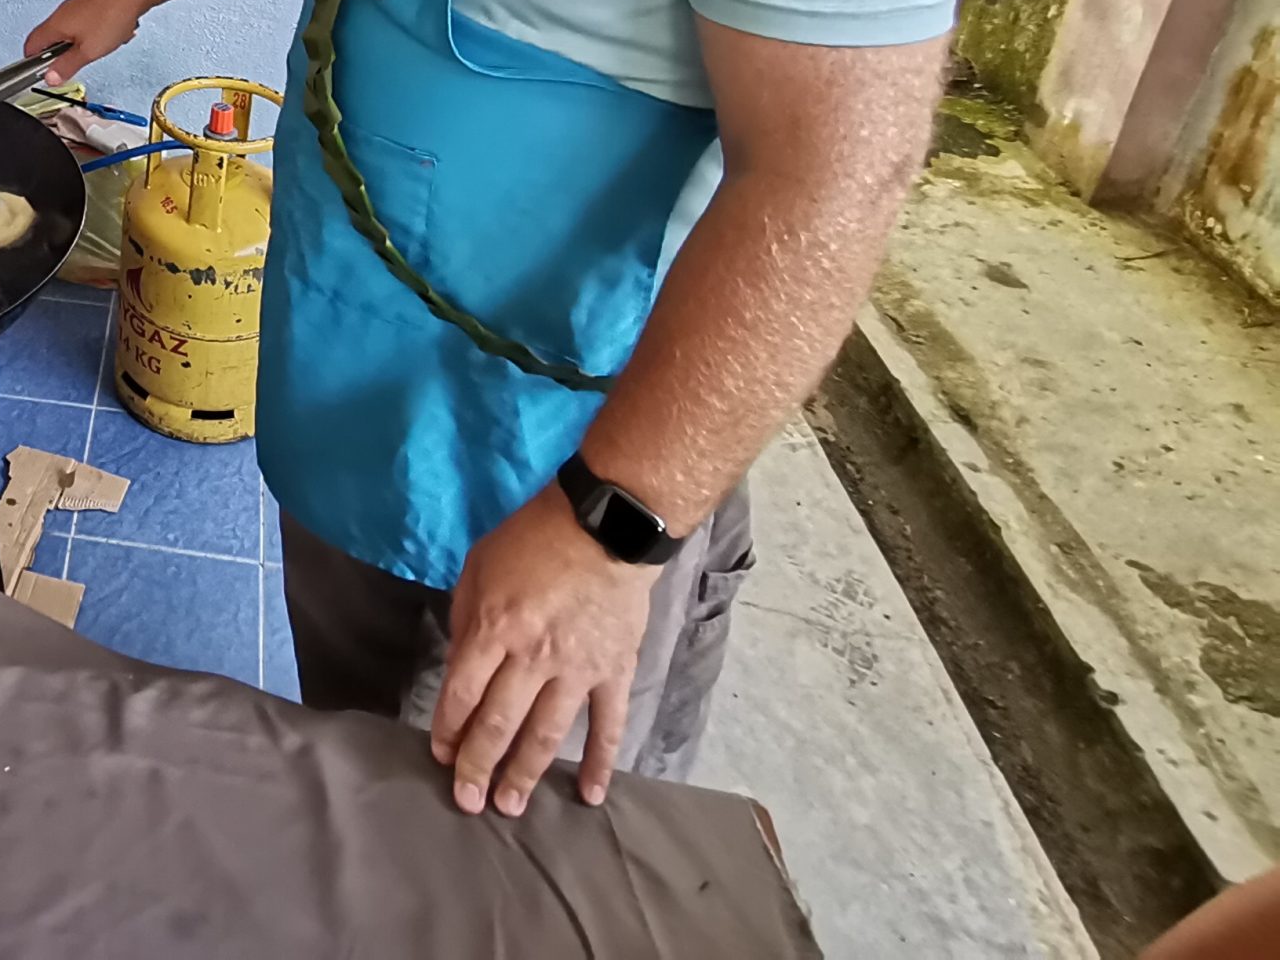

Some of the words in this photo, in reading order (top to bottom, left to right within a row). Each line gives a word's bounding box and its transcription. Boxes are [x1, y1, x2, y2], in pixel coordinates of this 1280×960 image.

[232, 92, 248, 110] 28
[122, 302, 189, 358] YGAZ
[135, 344, 162, 375] KG
